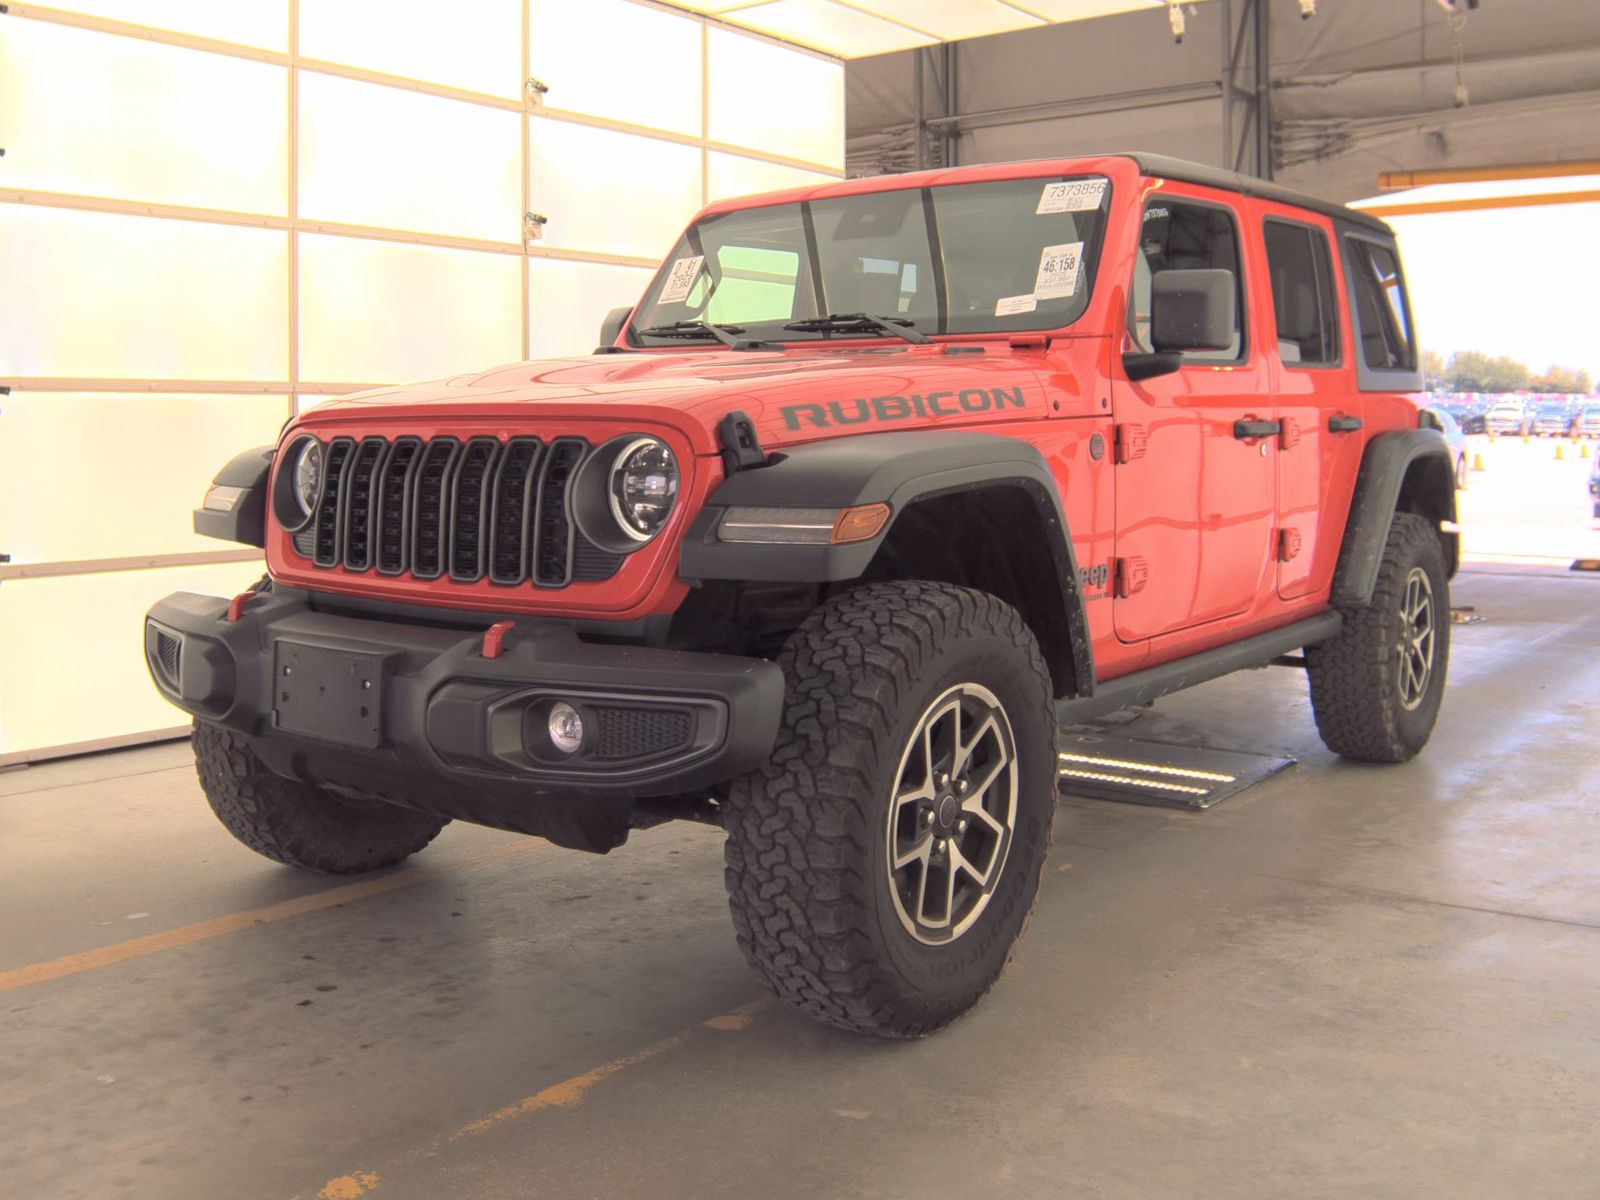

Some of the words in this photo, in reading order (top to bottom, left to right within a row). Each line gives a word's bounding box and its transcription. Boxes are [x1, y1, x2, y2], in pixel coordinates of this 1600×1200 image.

[1049, 182, 1106, 198] 7373856
[1043, 257, 1076, 273] 46:158
[780, 386, 1025, 432] RUBICON
[1078, 563, 1109, 589] eep
